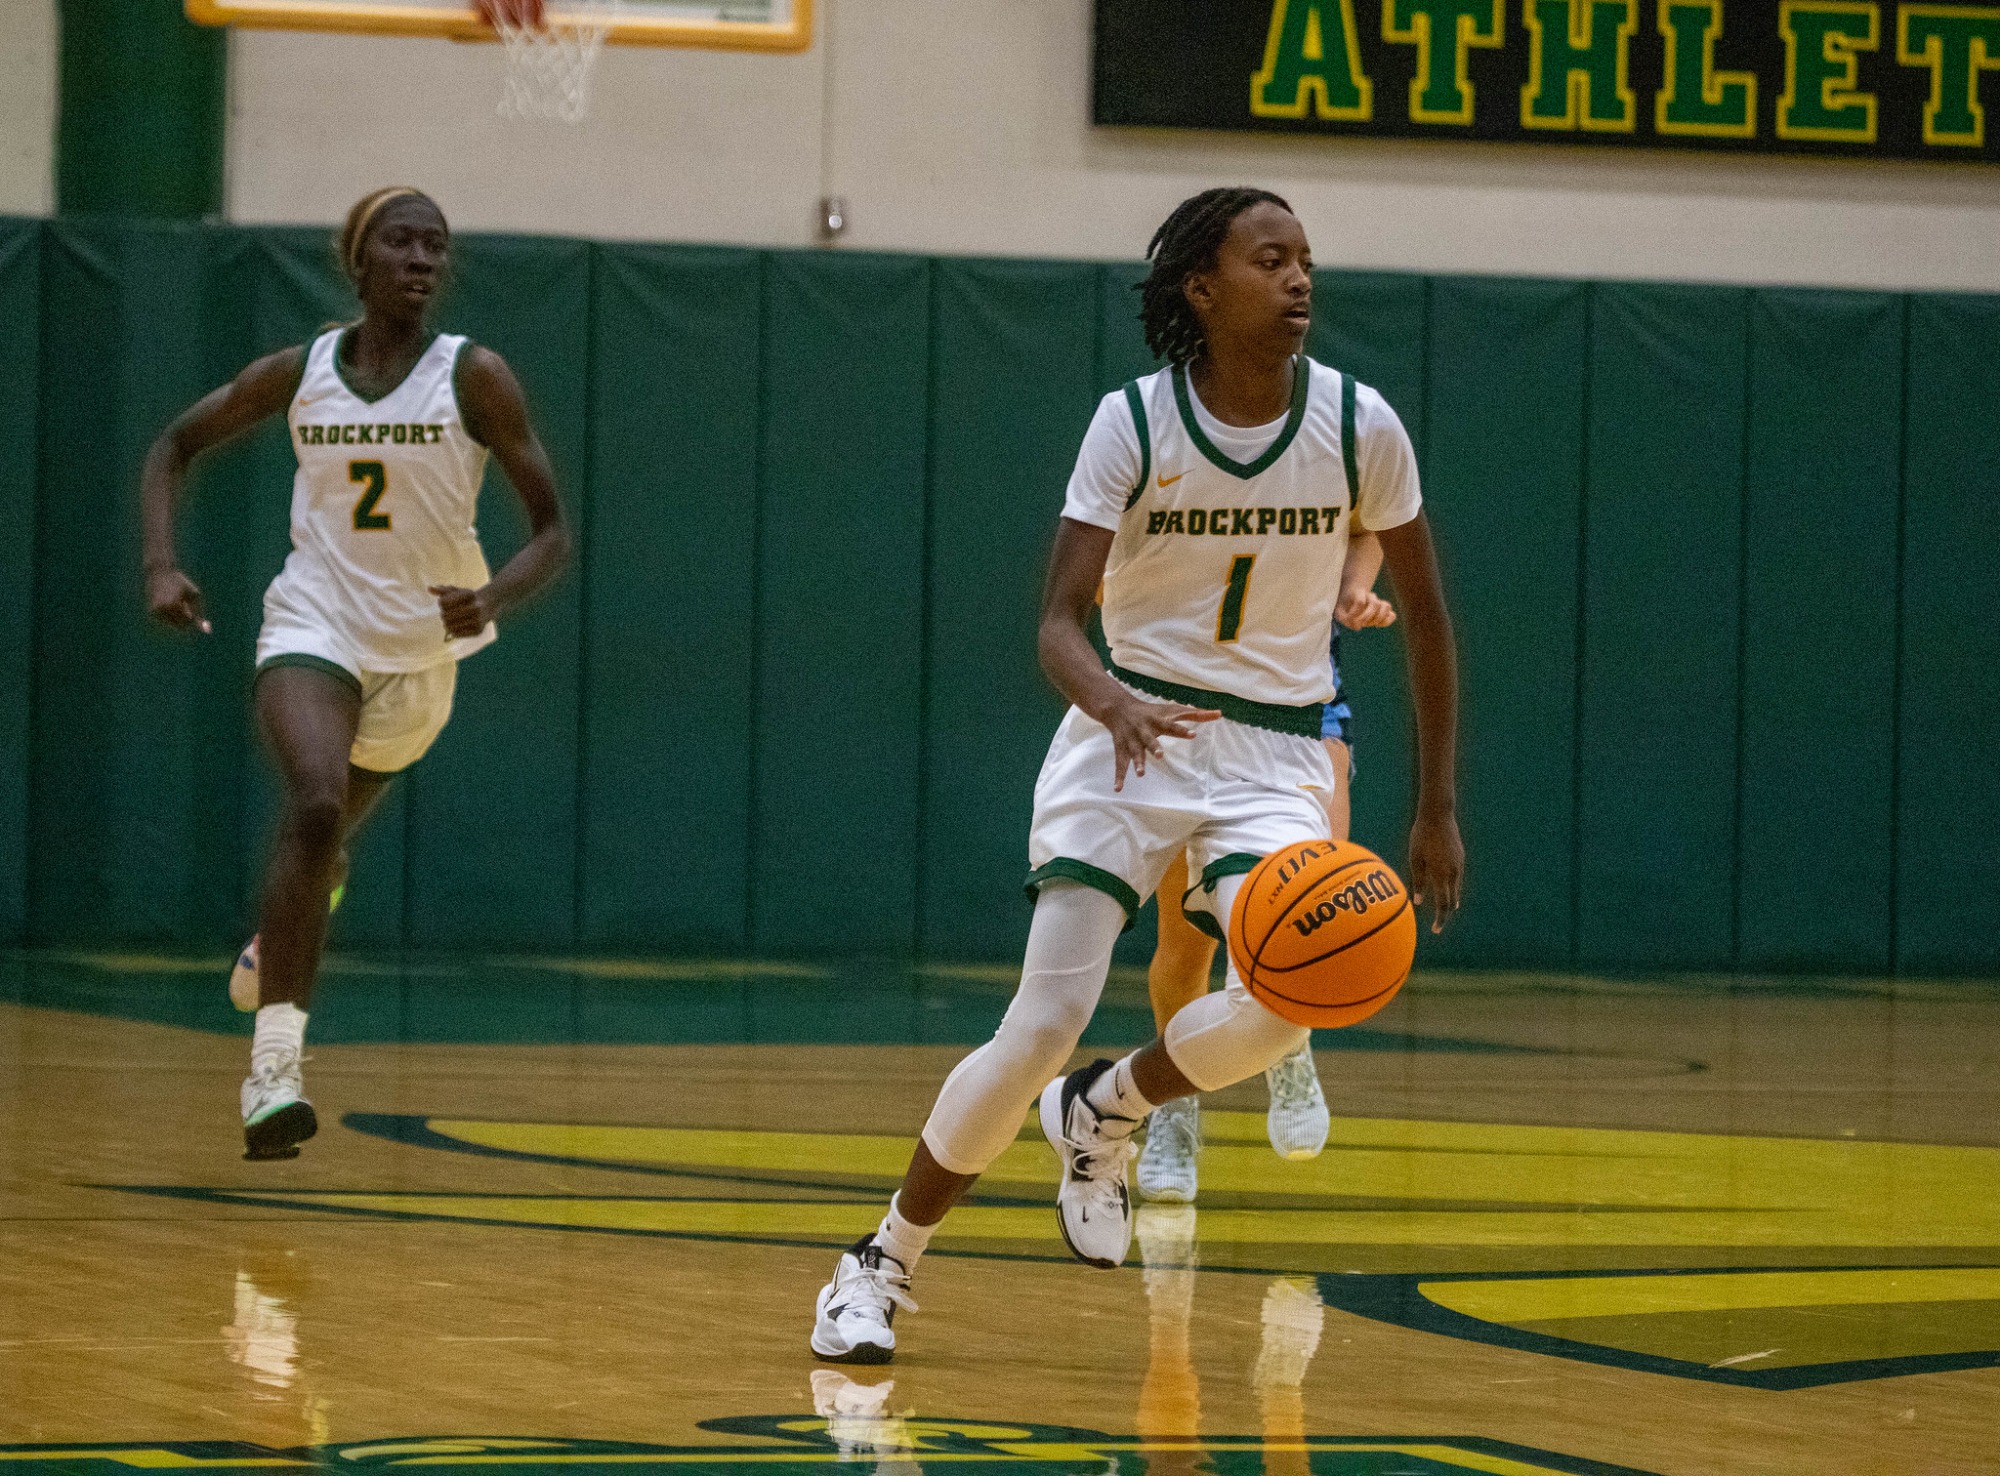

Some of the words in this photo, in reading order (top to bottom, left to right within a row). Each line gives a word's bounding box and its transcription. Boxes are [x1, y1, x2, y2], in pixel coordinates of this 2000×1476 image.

[1250, 0, 2000, 147] ATHLET
[348, 459, 392, 531] 2
[1146, 506, 1341, 536] BROCKPORT
[1216, 553, 1256, 644] 1
[1277, 841, 1338, 885] EVO
[1292, 869, 1398, 936] Wilson
